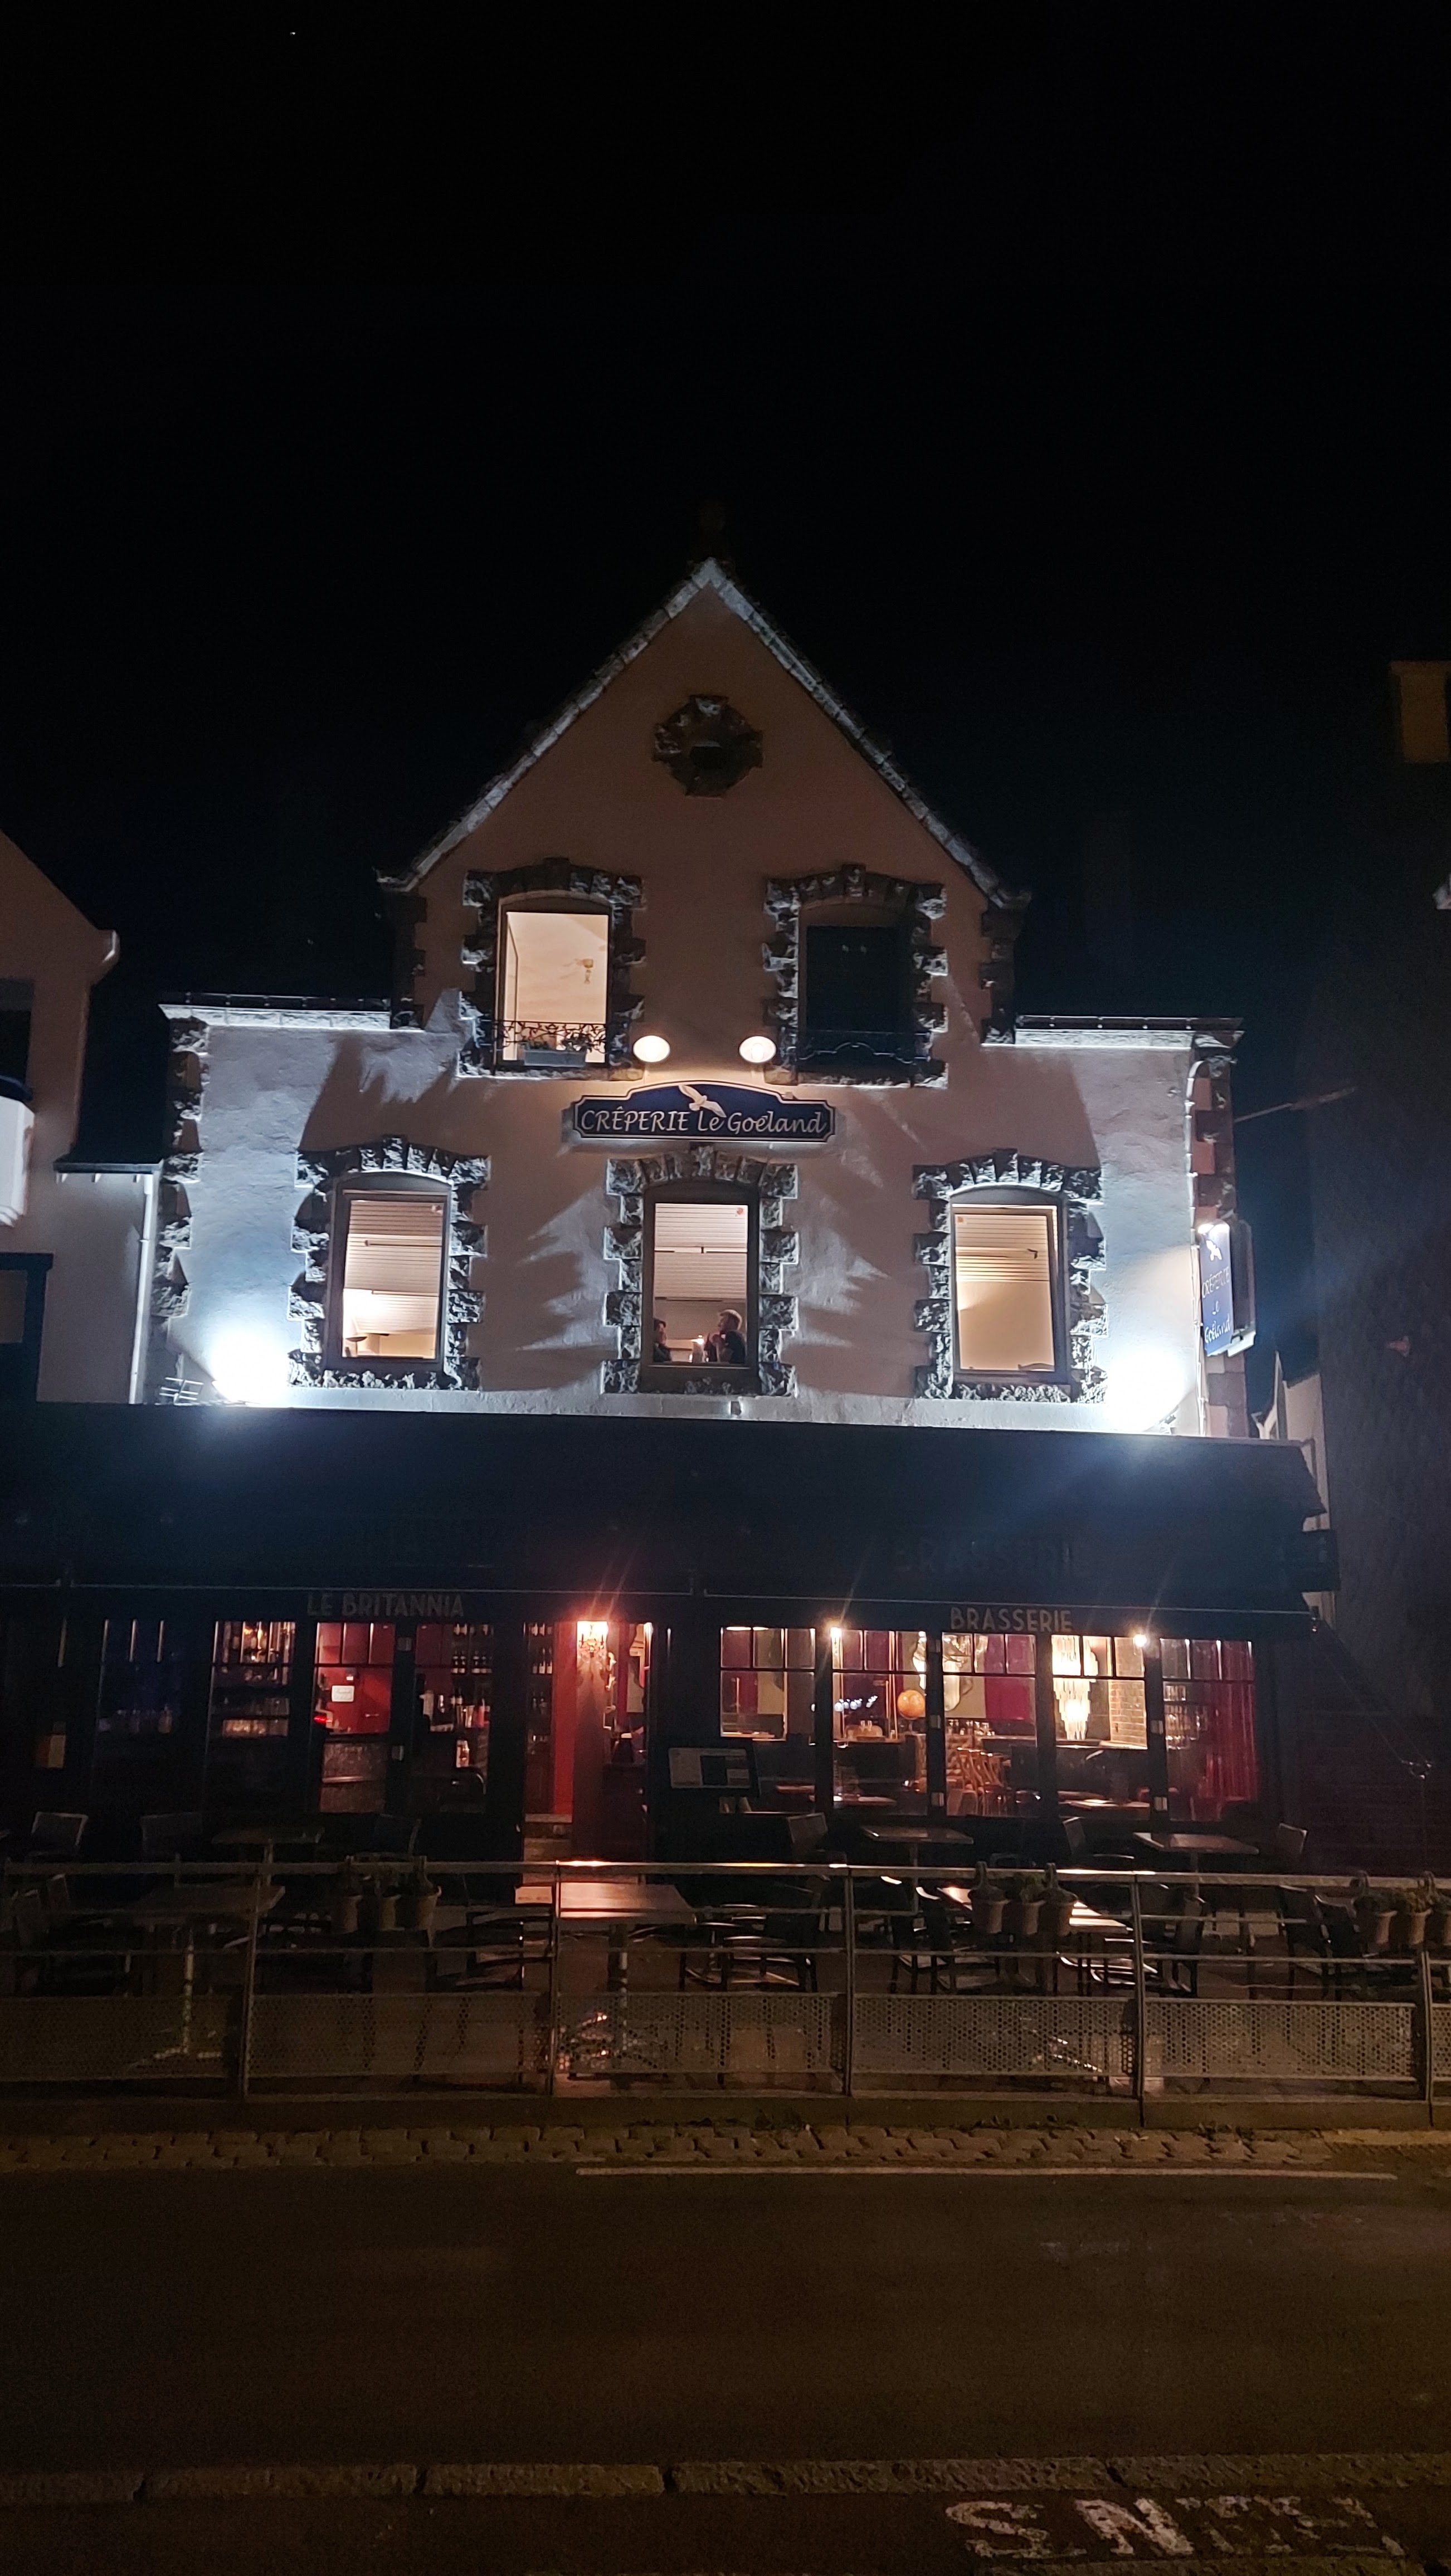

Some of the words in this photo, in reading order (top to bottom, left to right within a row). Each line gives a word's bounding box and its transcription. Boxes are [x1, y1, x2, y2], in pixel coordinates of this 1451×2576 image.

[581, 1106, 690, 1132] CRÊPERIE
[698, 1110, 724, 1131] Le
[308, 1591, 333, 1616] LE
[341, 1592, 464, 1616] BRITANNIA
[950, 1607, 1072, 1632] BRASSERIE
